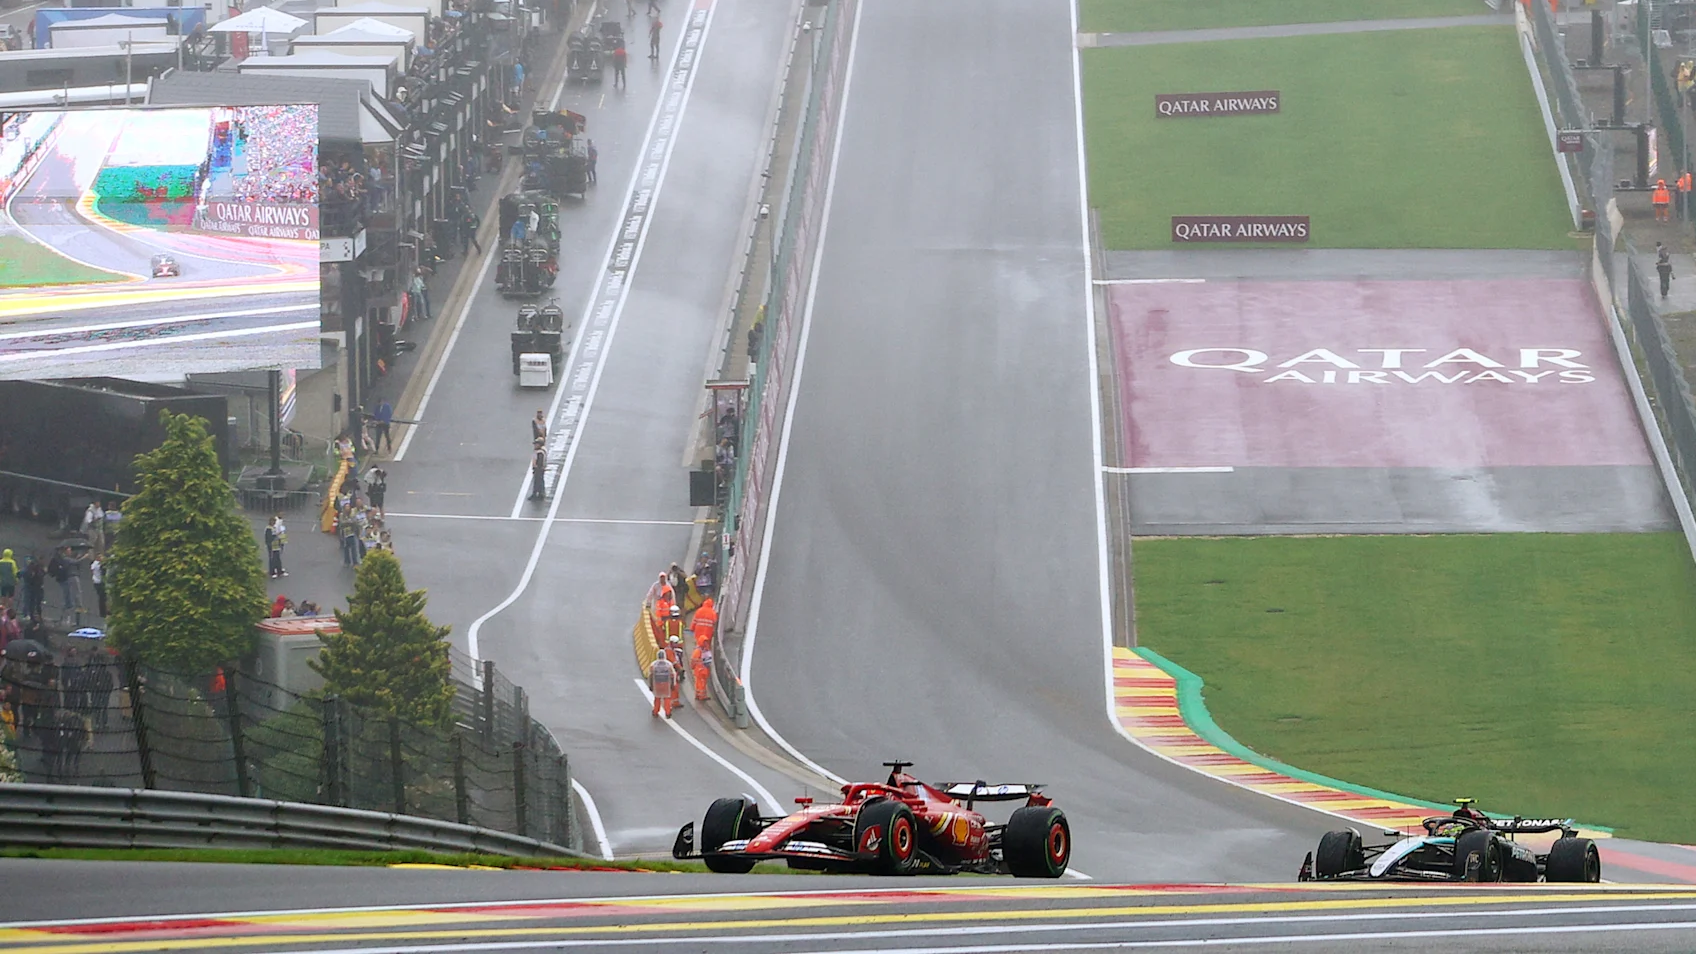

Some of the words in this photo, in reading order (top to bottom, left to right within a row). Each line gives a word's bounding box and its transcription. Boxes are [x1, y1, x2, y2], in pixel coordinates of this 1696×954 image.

[1159, 100, 1210, 115] QATAR
[1214, 97, 1277, 111] AIRWAYS
[217, 203, 251, 222] QATAR
[254, 204, 309, 227] AIRWAYS
[248, 224, 268, 236] QATAR
[269, 226, 299, 239] AIRWAYS
[1176, 224, 1232, 240] QATAR
[1236, 223, 1307, 237] AIRWAYS
[1170, 348, 1591, 372] QATAR
[1263, 370, 1596, 384] AIRWAYS
